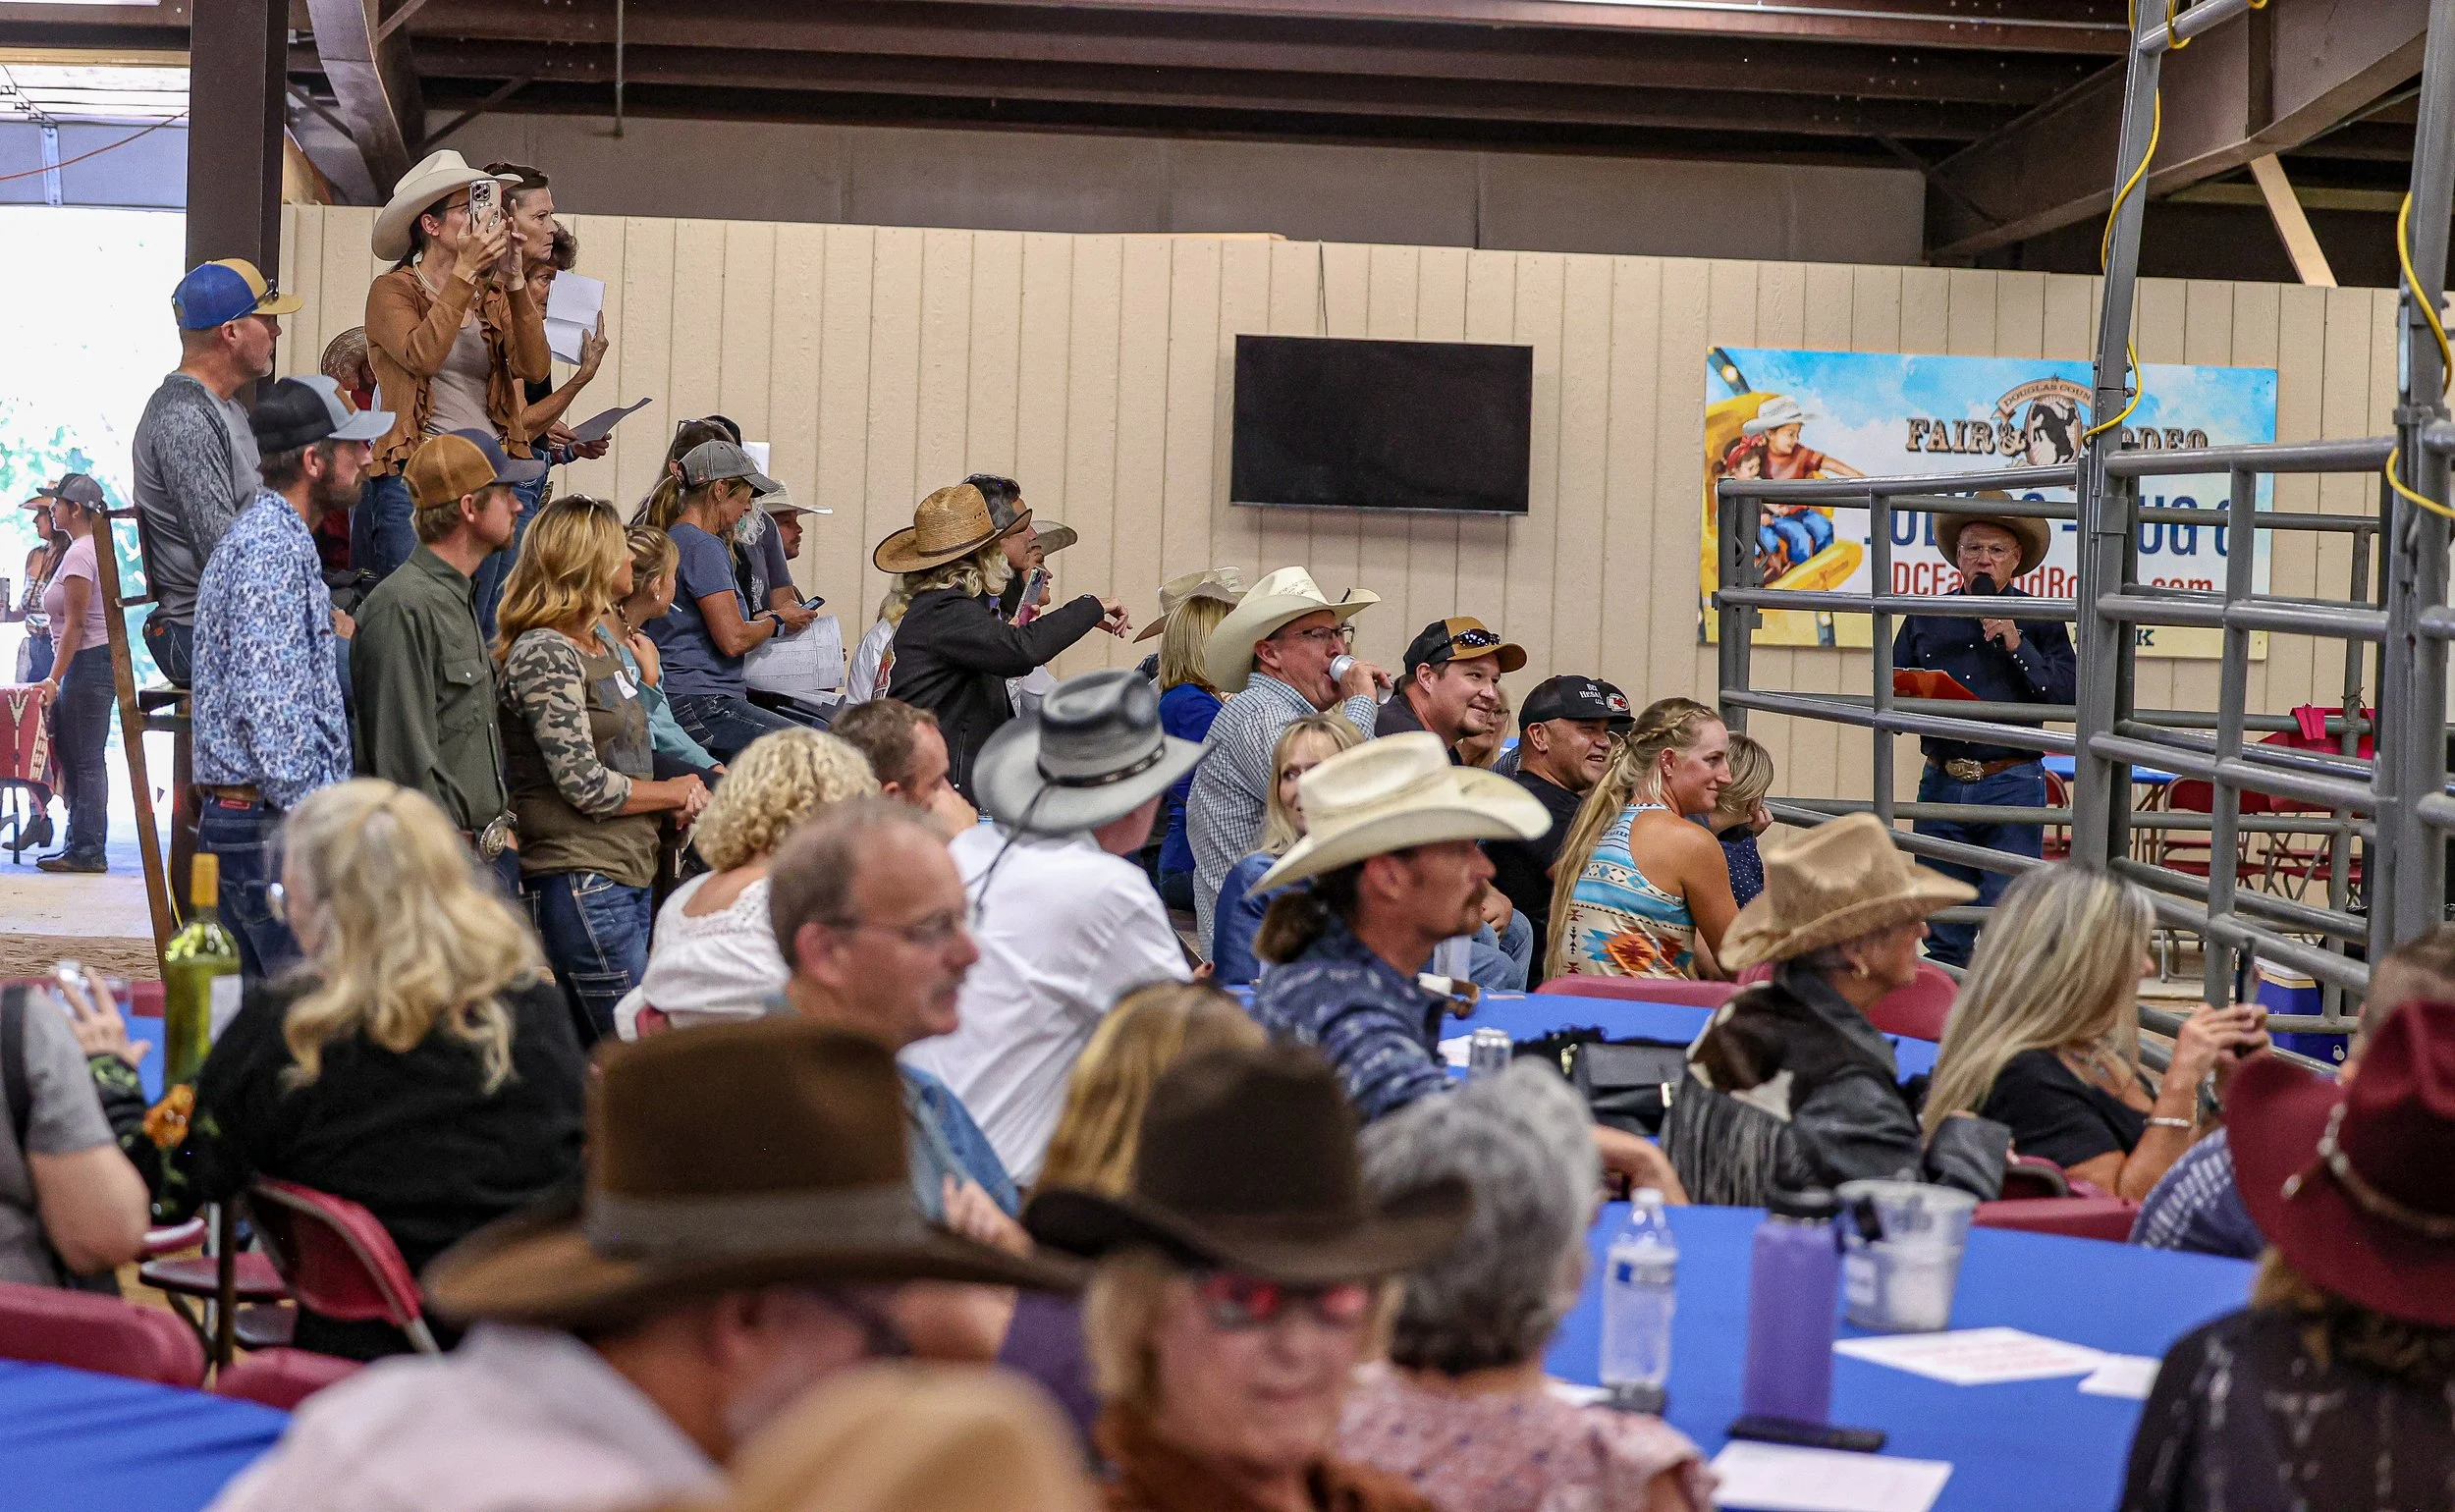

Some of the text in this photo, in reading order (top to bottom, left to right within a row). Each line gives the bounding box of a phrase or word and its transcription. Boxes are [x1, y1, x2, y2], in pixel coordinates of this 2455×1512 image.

[2003, 384, 2091, 406] DOUGLAS COUN
[1906, 417, 1995, 455] FAIR
[2137, 495, 2198, 556] UG
